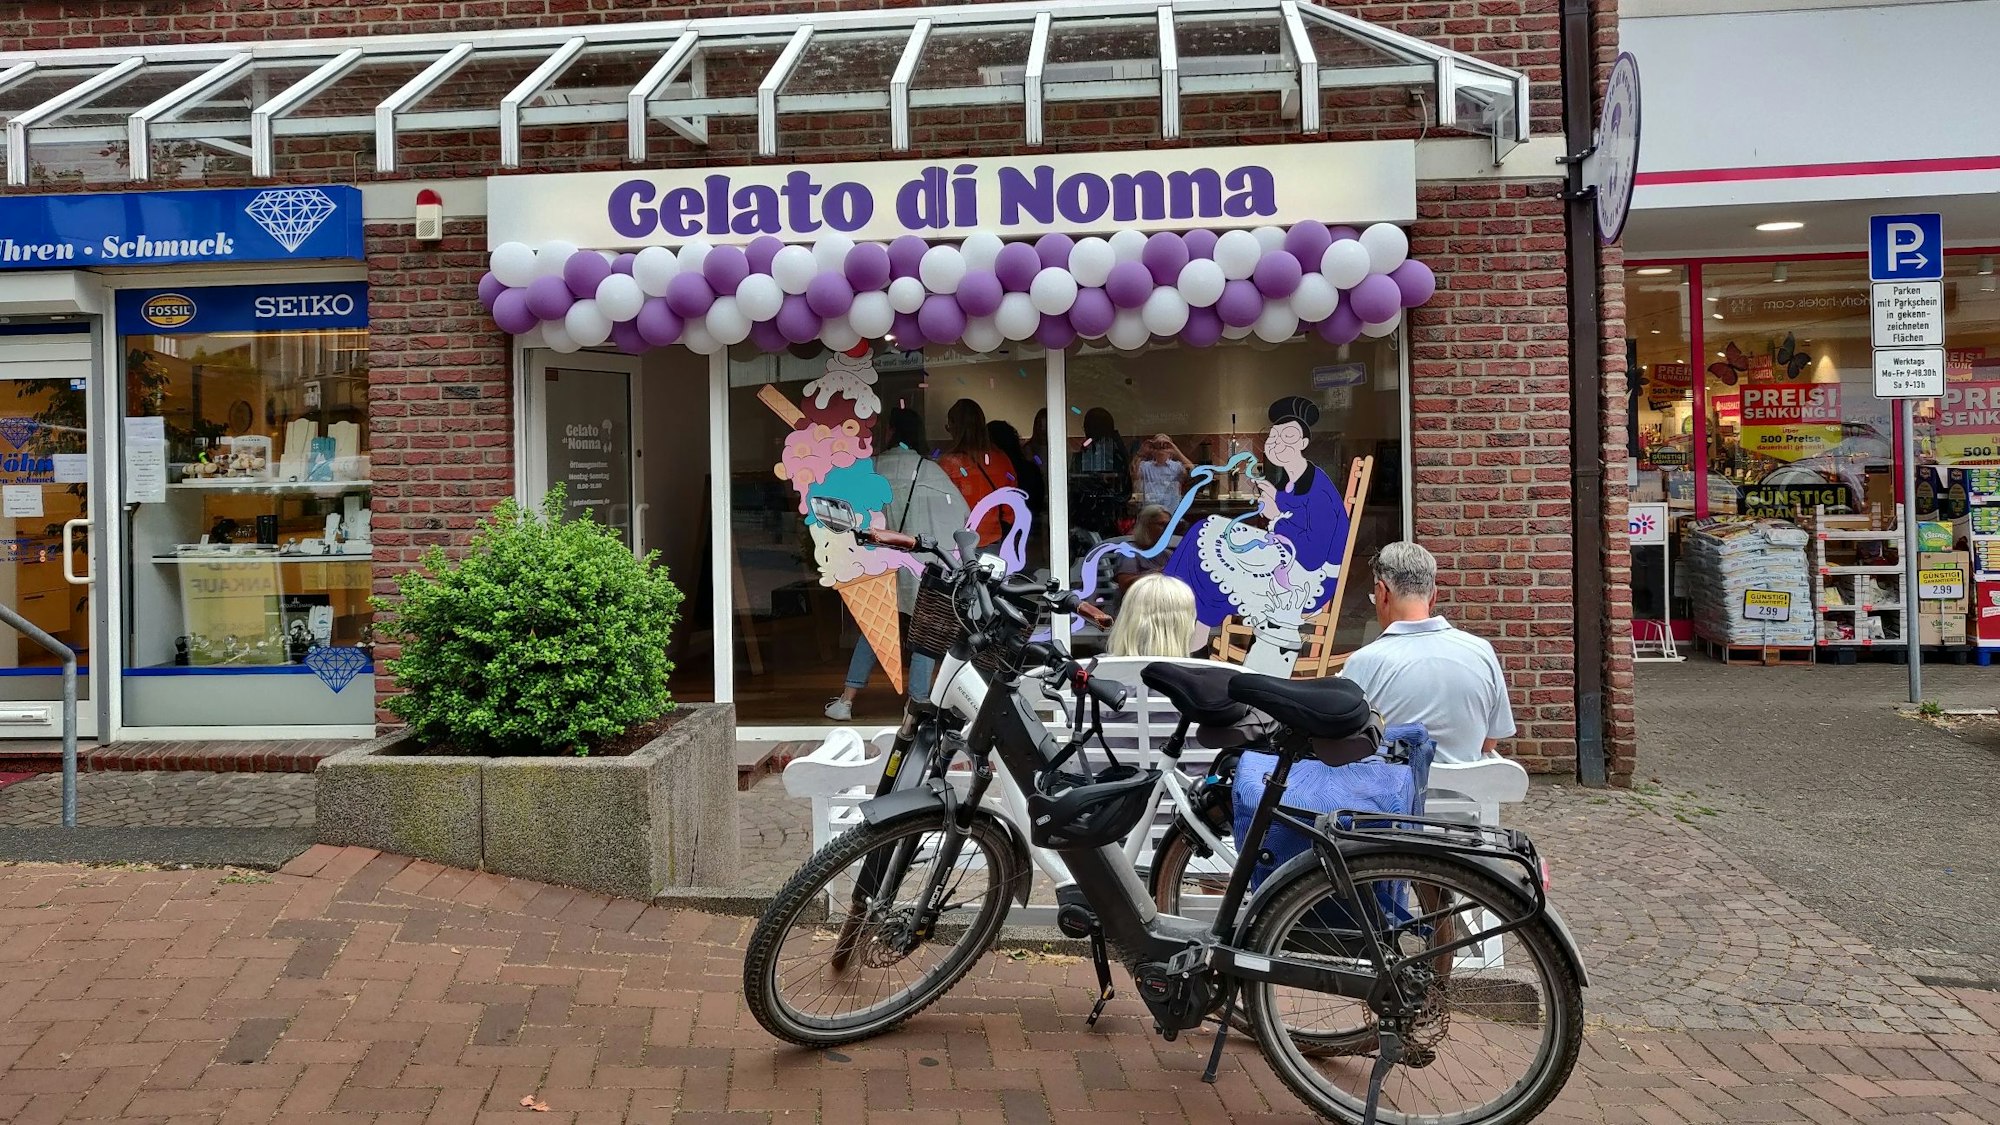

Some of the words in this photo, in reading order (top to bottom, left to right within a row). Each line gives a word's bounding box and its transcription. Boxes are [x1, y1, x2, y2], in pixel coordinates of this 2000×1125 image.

[608, 170, 873, 238] Gelato
[896, 164, 978, 230] di
[998, 165, 1278, 225] Nonna
[101, 232, 235, 259] Schmuck
[1886, 222, 1925, 272] P
[1893, 286, 1921, 296] Parken
[254, 293, 354, 318] SEIKO
[1877, 299, 1891, 308] mit
[1894, 297, 1938, 309] Parkschein
[148, 305, 191, 316] FOSSIL
[1886, 310, 1894, 319] in
[1897, 309, 1931, 321] gekenn-
[1887, 321, 1930, 331] zeichneten
[1892, 333, 1924, 343] Flächen
[1893, 358, 1925, 367] Werktags
[1893, 381, 1902, 389] Sa
[1941, 386, 2000, 411] PRE
[1940, 411, 2000, 427] SENK
[565, 424, 599, 437] Gelato
[568, 437, 601, 450] Nonna
[1760, 435, 1782, 443] 500
[1785, 434, 1821, 443] Preise
[1963, 446, 1992, 457] 500
[1932, 585, 1952, 595] 2.99
[1759, 606, 1778, 616] 2.99
